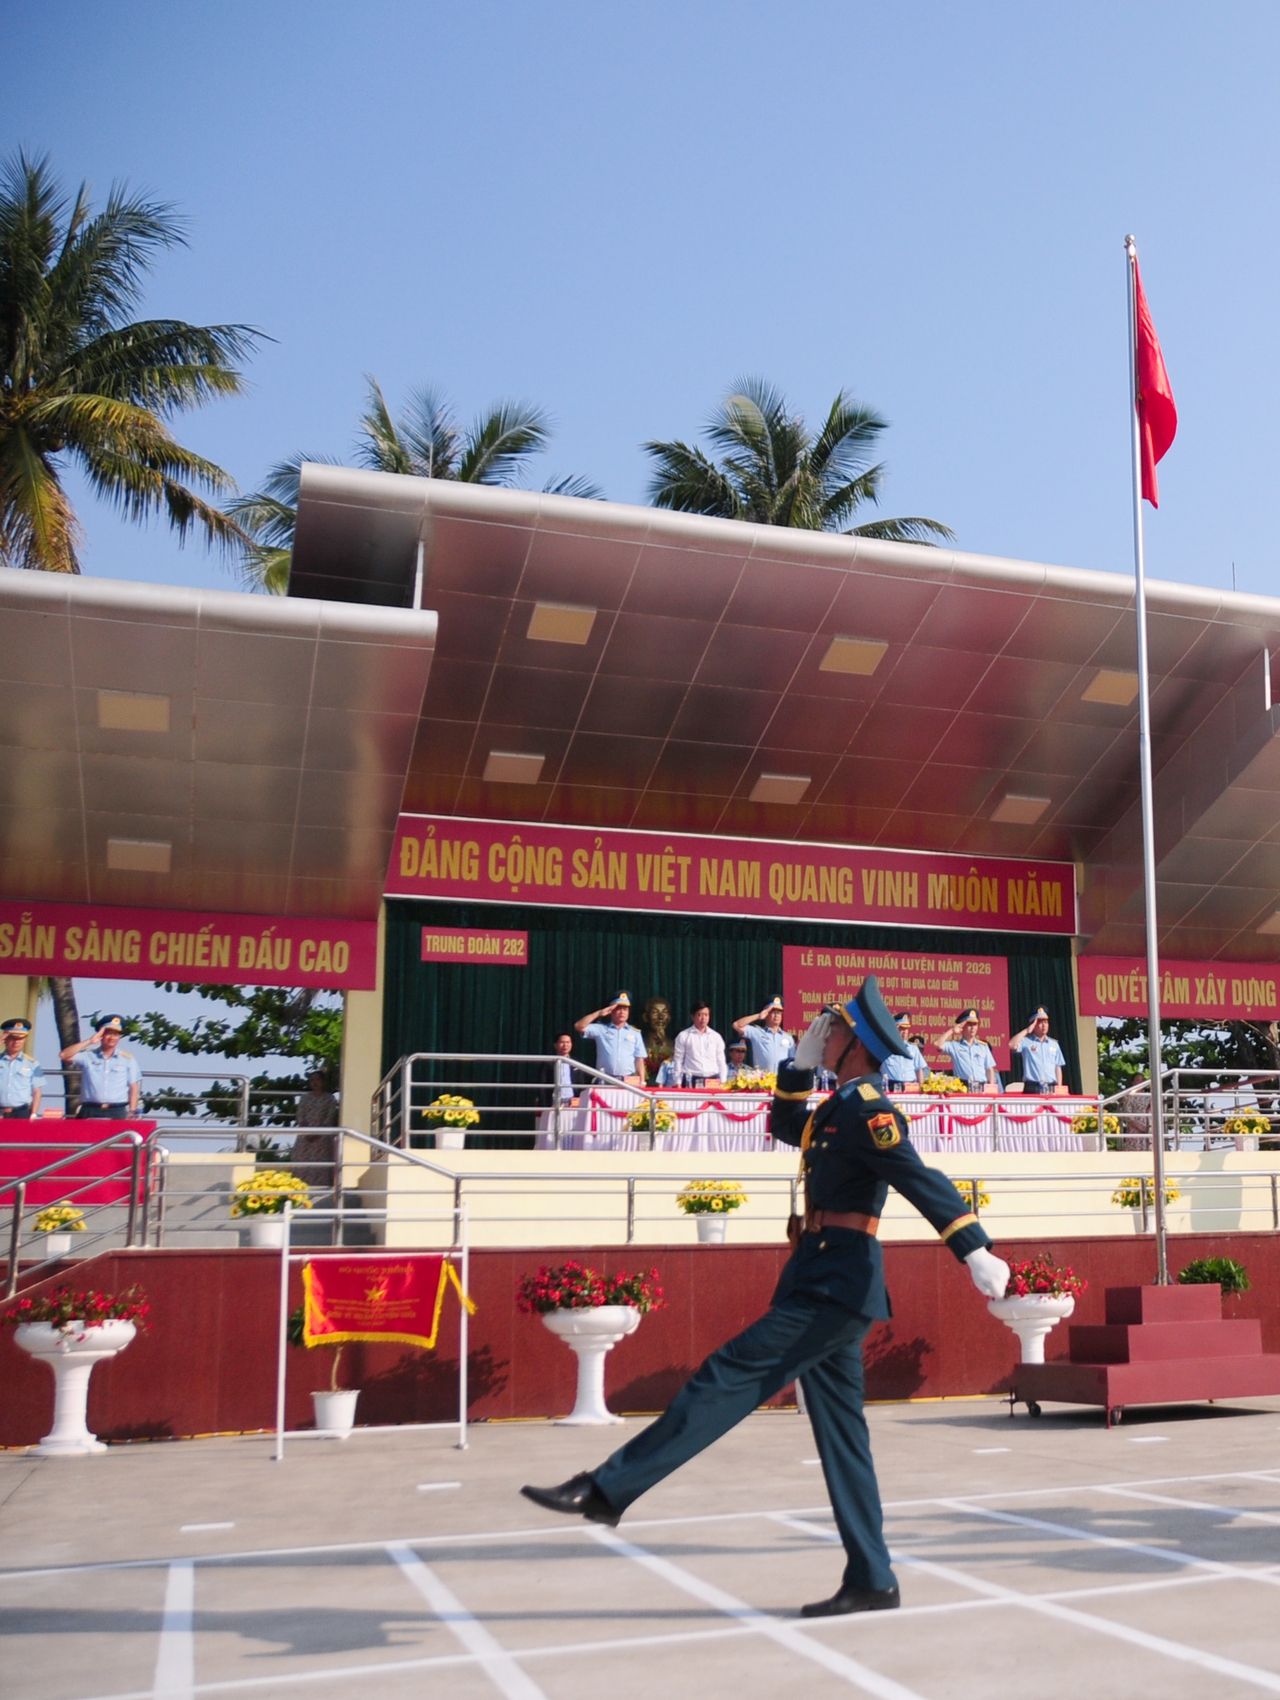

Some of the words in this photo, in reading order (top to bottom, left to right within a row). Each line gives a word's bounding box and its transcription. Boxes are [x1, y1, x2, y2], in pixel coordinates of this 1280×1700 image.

[399, 824, 480, 881] ĐẢNG
[488, 834, 563, 893] CỘNG
[571, 836, 627, 891] SẢN
[636, 845, 692, 902] VIỆT
[699, 856, 760, 899] NAM
[768, 862, 853, 905] QUANG
[861, 868, 918, 909] VINH
[927, 866, 998, 914] MUÔN
[1007, 870, 1062, 917] NĂM
[0, 911, 56, 960] SẴN
[64, 920, 141, 964] SÀNG
[149, 923, 230, 968] CHIẾN
[238, 926, 291, 971] ĐẤU
[300, 939, 349, 974] CAO
[425, 934, 464, 954] TRUNG
[467, 933, 500, 955] ĐOÀN
[503, 938, 525, 956] 282
[801, 949, 814, 966] LỄ
[817, 954, 832, 967] RA
[835, 953, 866, 969] QUÂN
[868, 953, 898, 970] HUẤN
[901, 957, 935, 974] LUYỆN
[938, 958, 963, 973] NĂM
[966, 961, 992, 975] 2026
[836, 972, 846, 986] VÀ
[901, 977, 911, 989] THI
[927, 979, 940, 990] CAO
[1095, 966, 1147, 1005] QUYẾT
[1194, 973, 1227, 1006] XÂY
[1231, 976, 1277, 1012] DỰNG
[920, 995, 939, 1008] HOÀN
[940, 996, 962, 1009] THÀNH
